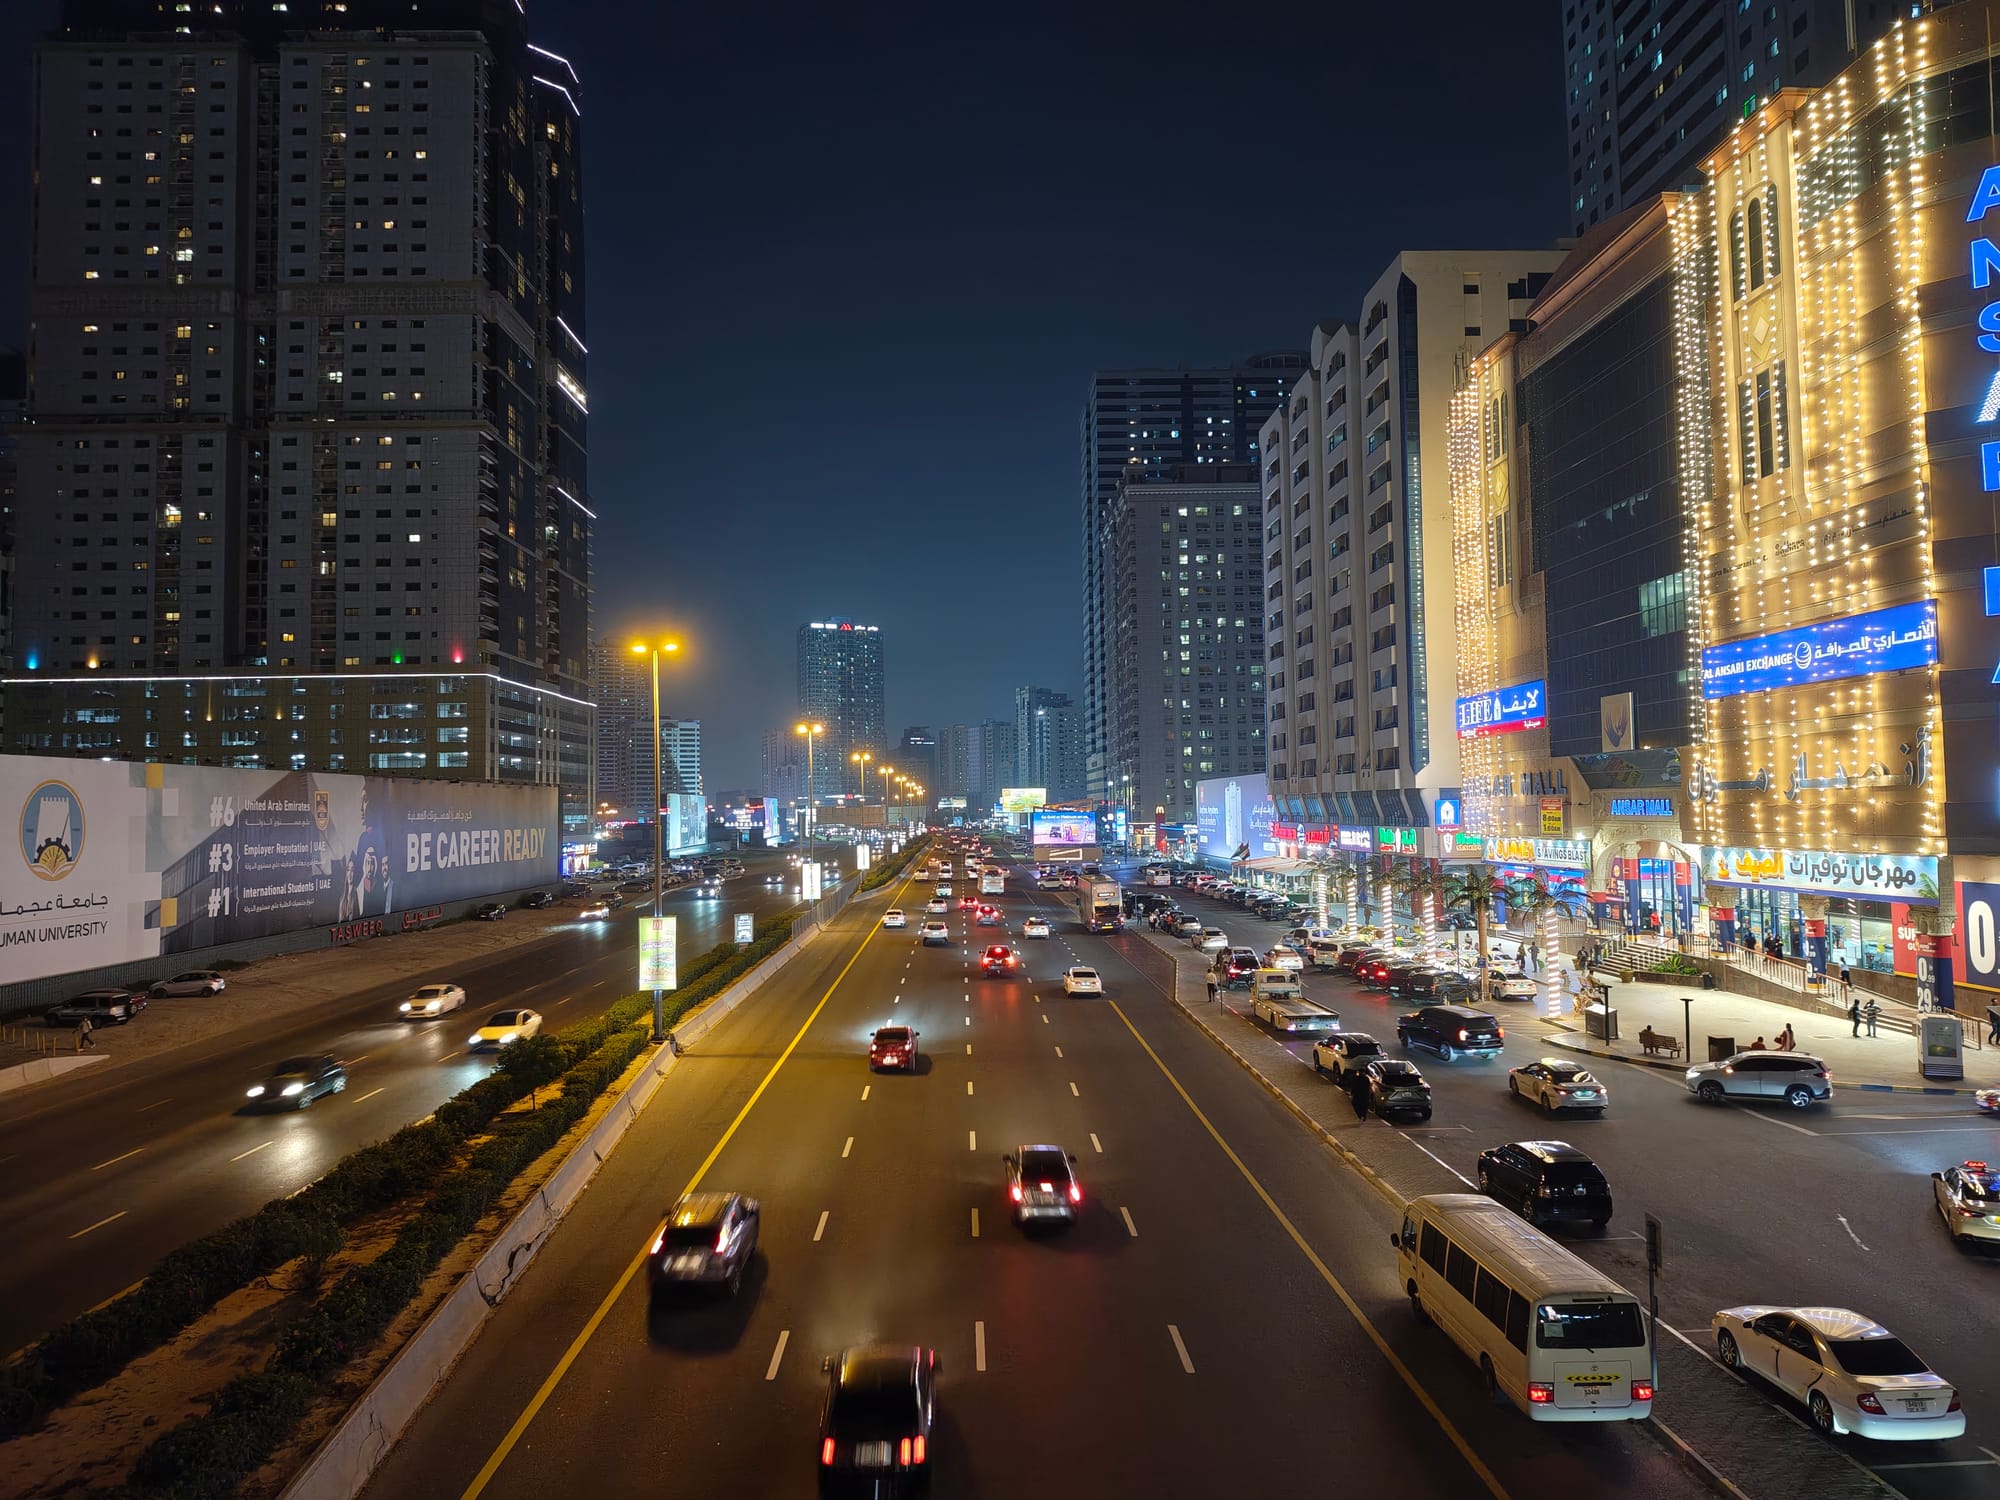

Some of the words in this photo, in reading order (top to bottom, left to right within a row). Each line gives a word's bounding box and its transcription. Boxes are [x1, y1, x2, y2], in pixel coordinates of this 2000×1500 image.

[1814, 636, 1870, 660] للصرافة
[1703, 668, 1714, 680] AL
[1714, 661, 1744, 677] ANSARI
[1746, 653, 1793, 671] EXCHANGE
[1459, 698, 1492, 726] LIFE
[1502, 689, 1539, 715] لايف
[1520, 769, 1569, 796] MALL
[210, 796, 235, 827] #6
[245, 800, 266, 812] United
[267, 800, 282, 811] Arab
[284, 800, 311, 812] Emirates
[1610, 799, 1645, 816] ANSAR
[1645, 799, 1673, 816] MALL
[209, 843, 233, 872] #3
[244, 844, 274, 857] Employer
[276, 842, 309, 856] Reputation
[407, 832, 432, 873] BE
[436, 829, 500, 869] CAREER
[503, 827, 546, 862] READY
[1496, 839, 1536, 862] SUMMER
[1568, 848, 1587, 861] BLAST
[1735, 851, 1785, 882] الصيف
[1790, 853, 1849, 885] توفيرات
[1852, 857, 1916, 889] مهرجان
[56, 892, 108, 909] جامعة
[208, 887, 230, 917] #1
[243, 884, 286, 898] International
[288, 881, 314, 894] Students
[319, 879, 331, 890] UAE
[38, 921, 109, 943] UNIVERSITY
